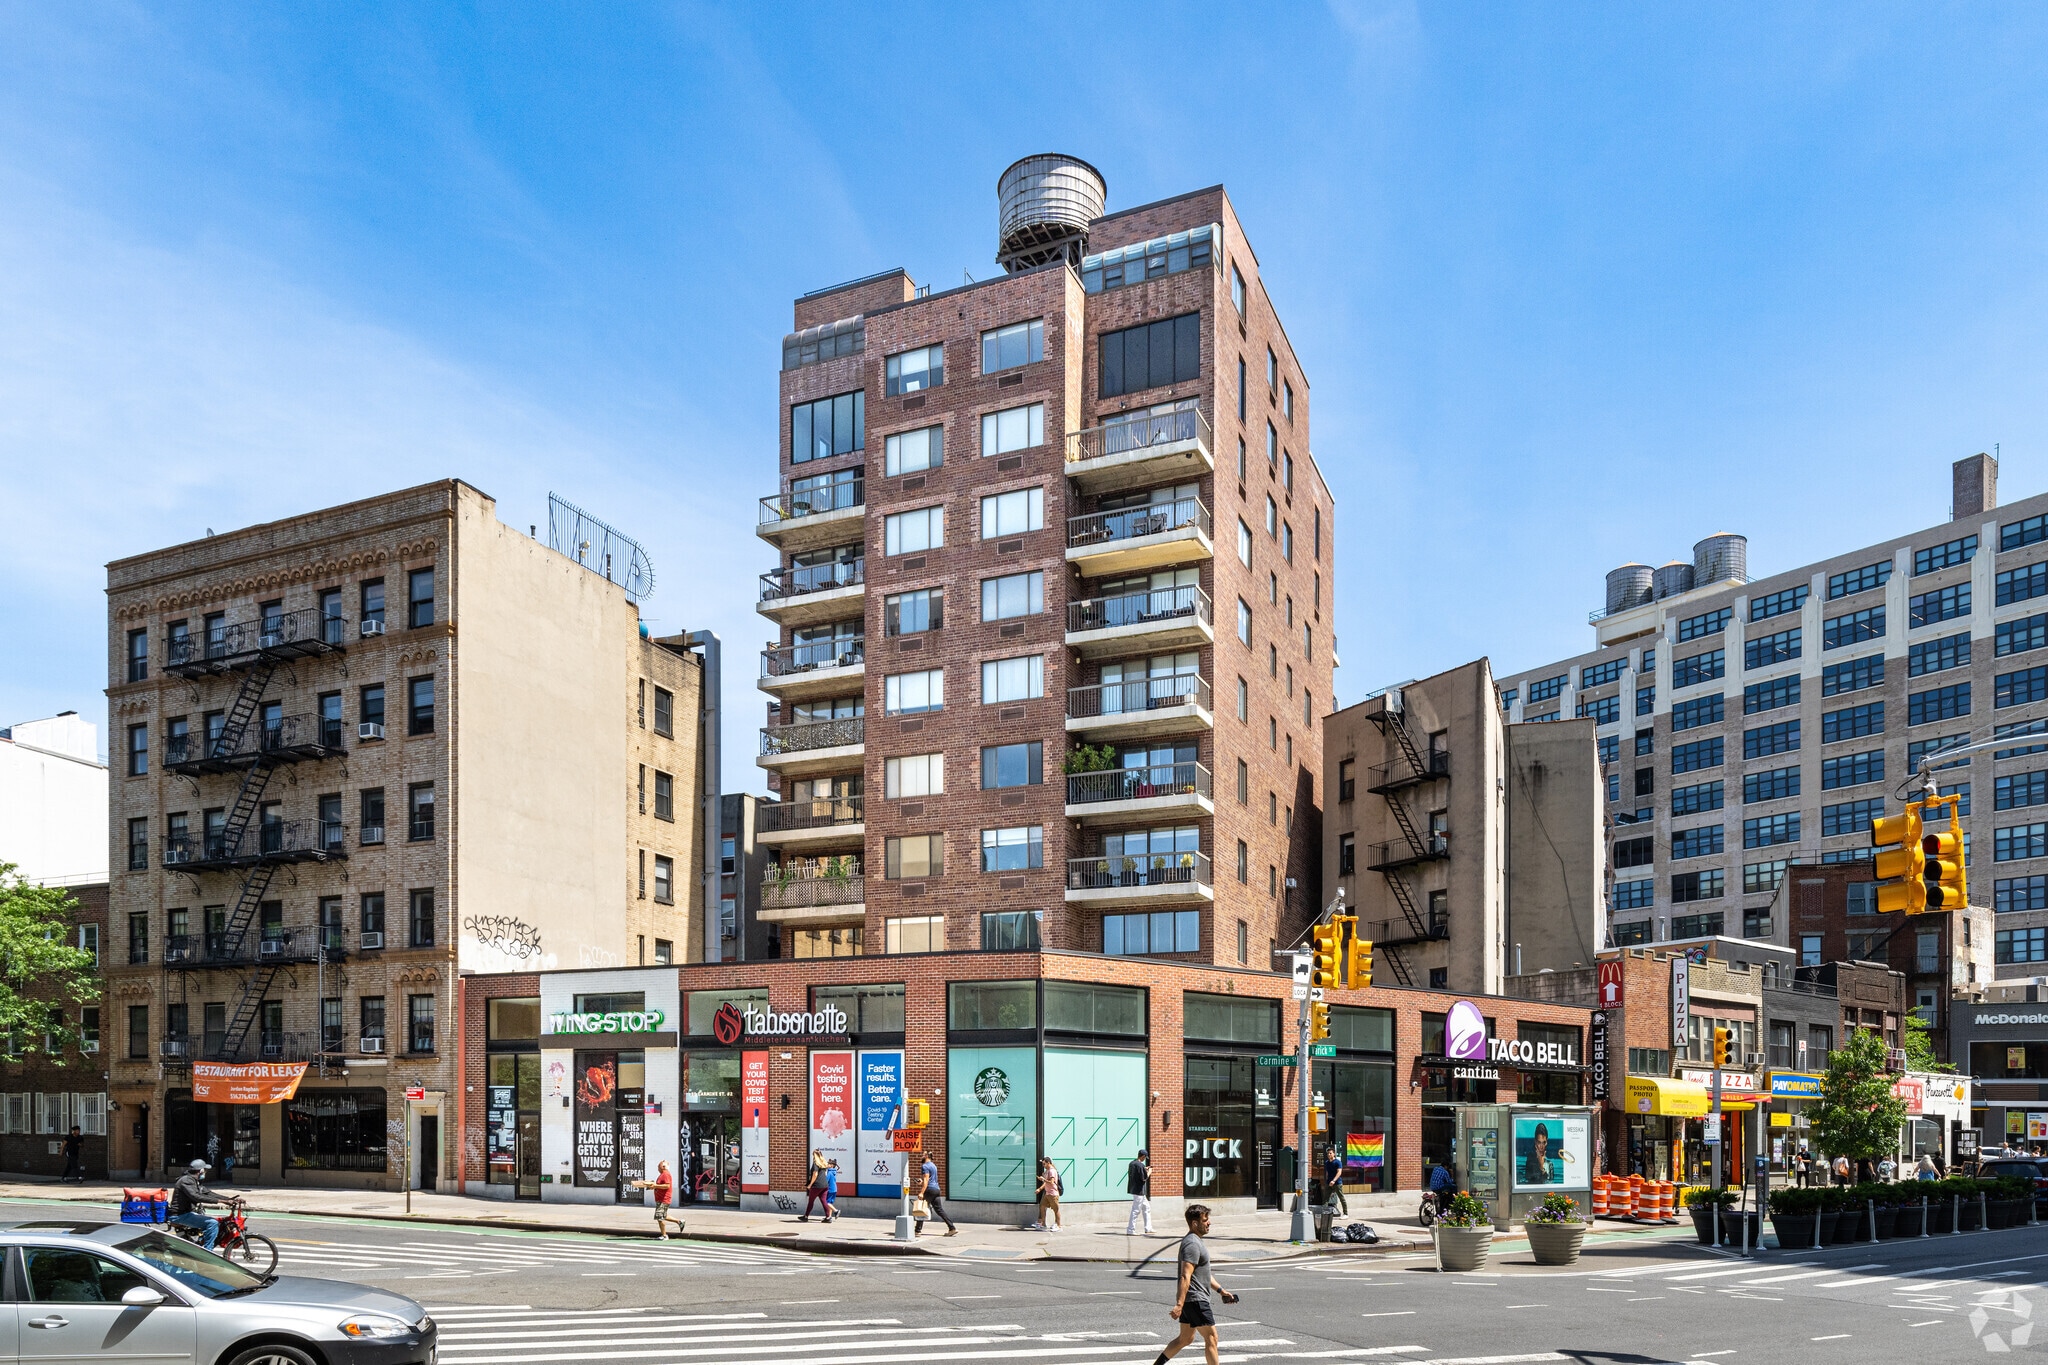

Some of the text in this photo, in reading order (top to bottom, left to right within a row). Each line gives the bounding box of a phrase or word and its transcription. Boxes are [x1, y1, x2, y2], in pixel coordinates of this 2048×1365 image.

[1676, 973, 1686, 1044] PIZZA
[744, 1002, 847, 1034] taboonette
[1488, 1038, 1576, 1065] TACO BELL
[1260, 1056, 1290, 1065] Carmine
[1594, 1028, 1604, 1098] TACO BELL
[195, 1065, 248, 1077] RESTAURANT
[249, 1066, 269, 1077] FOR
[820, 1065, 844, 1073] Covid
[868, 1064, 895, 1072] Faster
[1454, 1066, 1501, 1079] cantina
[817, 1074, 847, 1085] testing
[867, 1073, 896, 1081] results.
[821, 1084, 843, 1092] done
[868, 1085, 895, 1094] Better
[1900, 1085, 1914, 1098] WOK
[822, 1094, 843, 1102] here.
[580, 1121, 612, 1132] WHERE
[578, 1133, 613, 1144] FLAVOR
[578, 1145, 614, 1156] GETS ITS
[1186, 1139, 1243, 1159] PICK
[581, 1157, 612, 1168] WINGS
[1185, 1166, 1216, 1186] UP
